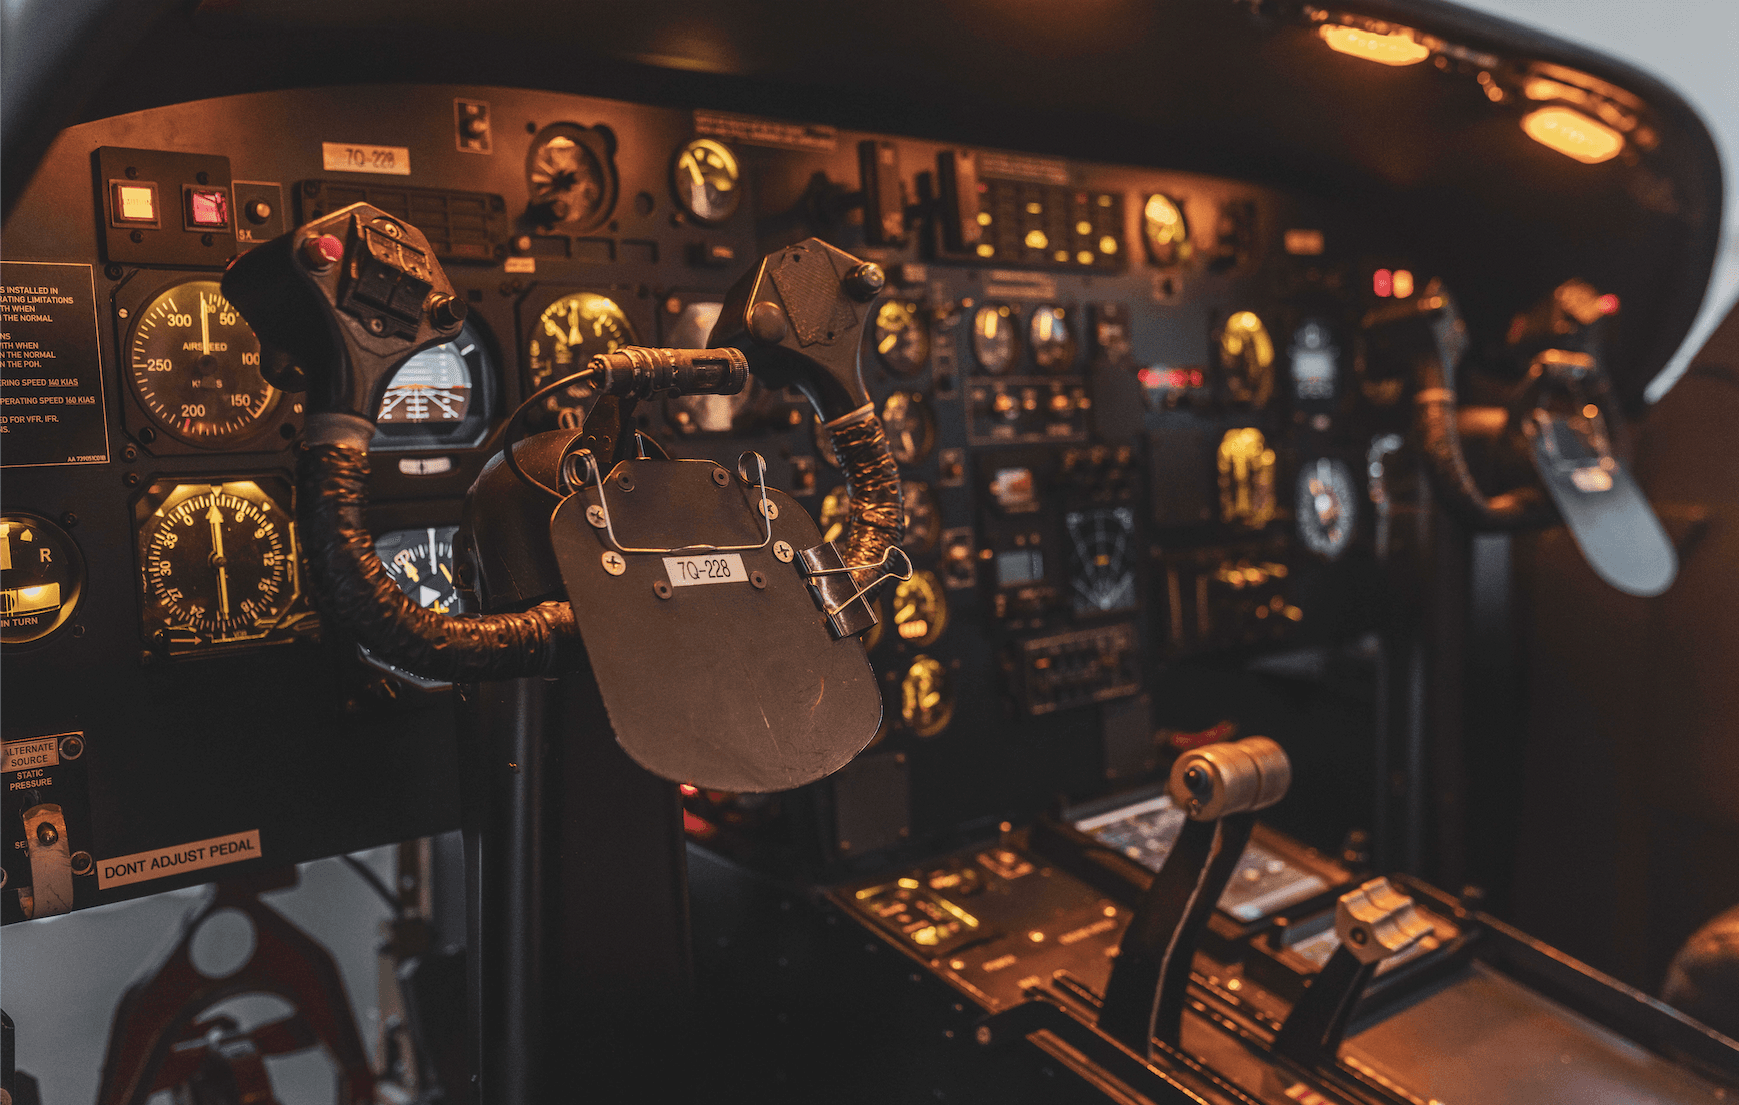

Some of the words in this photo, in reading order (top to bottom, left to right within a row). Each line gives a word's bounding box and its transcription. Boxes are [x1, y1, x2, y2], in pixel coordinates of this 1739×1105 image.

[6, 286, 49, 295] INSTALLED
[50, 287, 59, 295] IN
[27, 296, 74, 305] LIMITATIONS
[11, 305, 36, 313] WHEN
[3, 314, 19, 322] THE
[20, 314, 53, 322] NORMAL
[167, 313, 193, 328] 300
[219, 312, 236, 326] 50
[15, 342, 39, 350] WHEN
[182, 342, 228, 352] AIRSEED
[6, 351, 23, 359] THE
[23, 351, 57, 359] NORMAL
[241, 352, 261, 366] 100
[6, 360, 23, 368] THE
[23, 360, 42, 368] POH.
[147, 358, 173, 372] 250
[21, 378, 47, 387] SPEED
[60, 378, 79, 387] KIAS
[39, 396, 64, 405] SPEED
[77, 396, 96, 404] KIAS
[230, 393, 251, 407] 150
[181, 403, 206, 418] 200
[9, 415, 25, 424] FOR
[235, 511, 246, 523] 6
[163, 531, 179, 550] 33
[39, 547, 53, 563] R
[262, 551, 276, 567] 12
[159, 560, 172, 577] 30
[676, 558, 731, 581] 7Q-228
[257, 577, 271, 592] 15
[166, 587, 184, 603] 27
[189, 603, 206, 619] 24
[240, 597, 255, 613] 18
[12, 616, 39, 627] TURN
[4, 742, 55, 757] ALTERNATE
[11, 754, 49, 768] SOURCE
[16, 768, 44, 780] STATIC
[9, 777, 53, 791] PRESSURE
[104, 859, 147, 879] DONT
[150, 847, 206, 871] ADJUST
[209, 838, 255, 858] PEDAL
